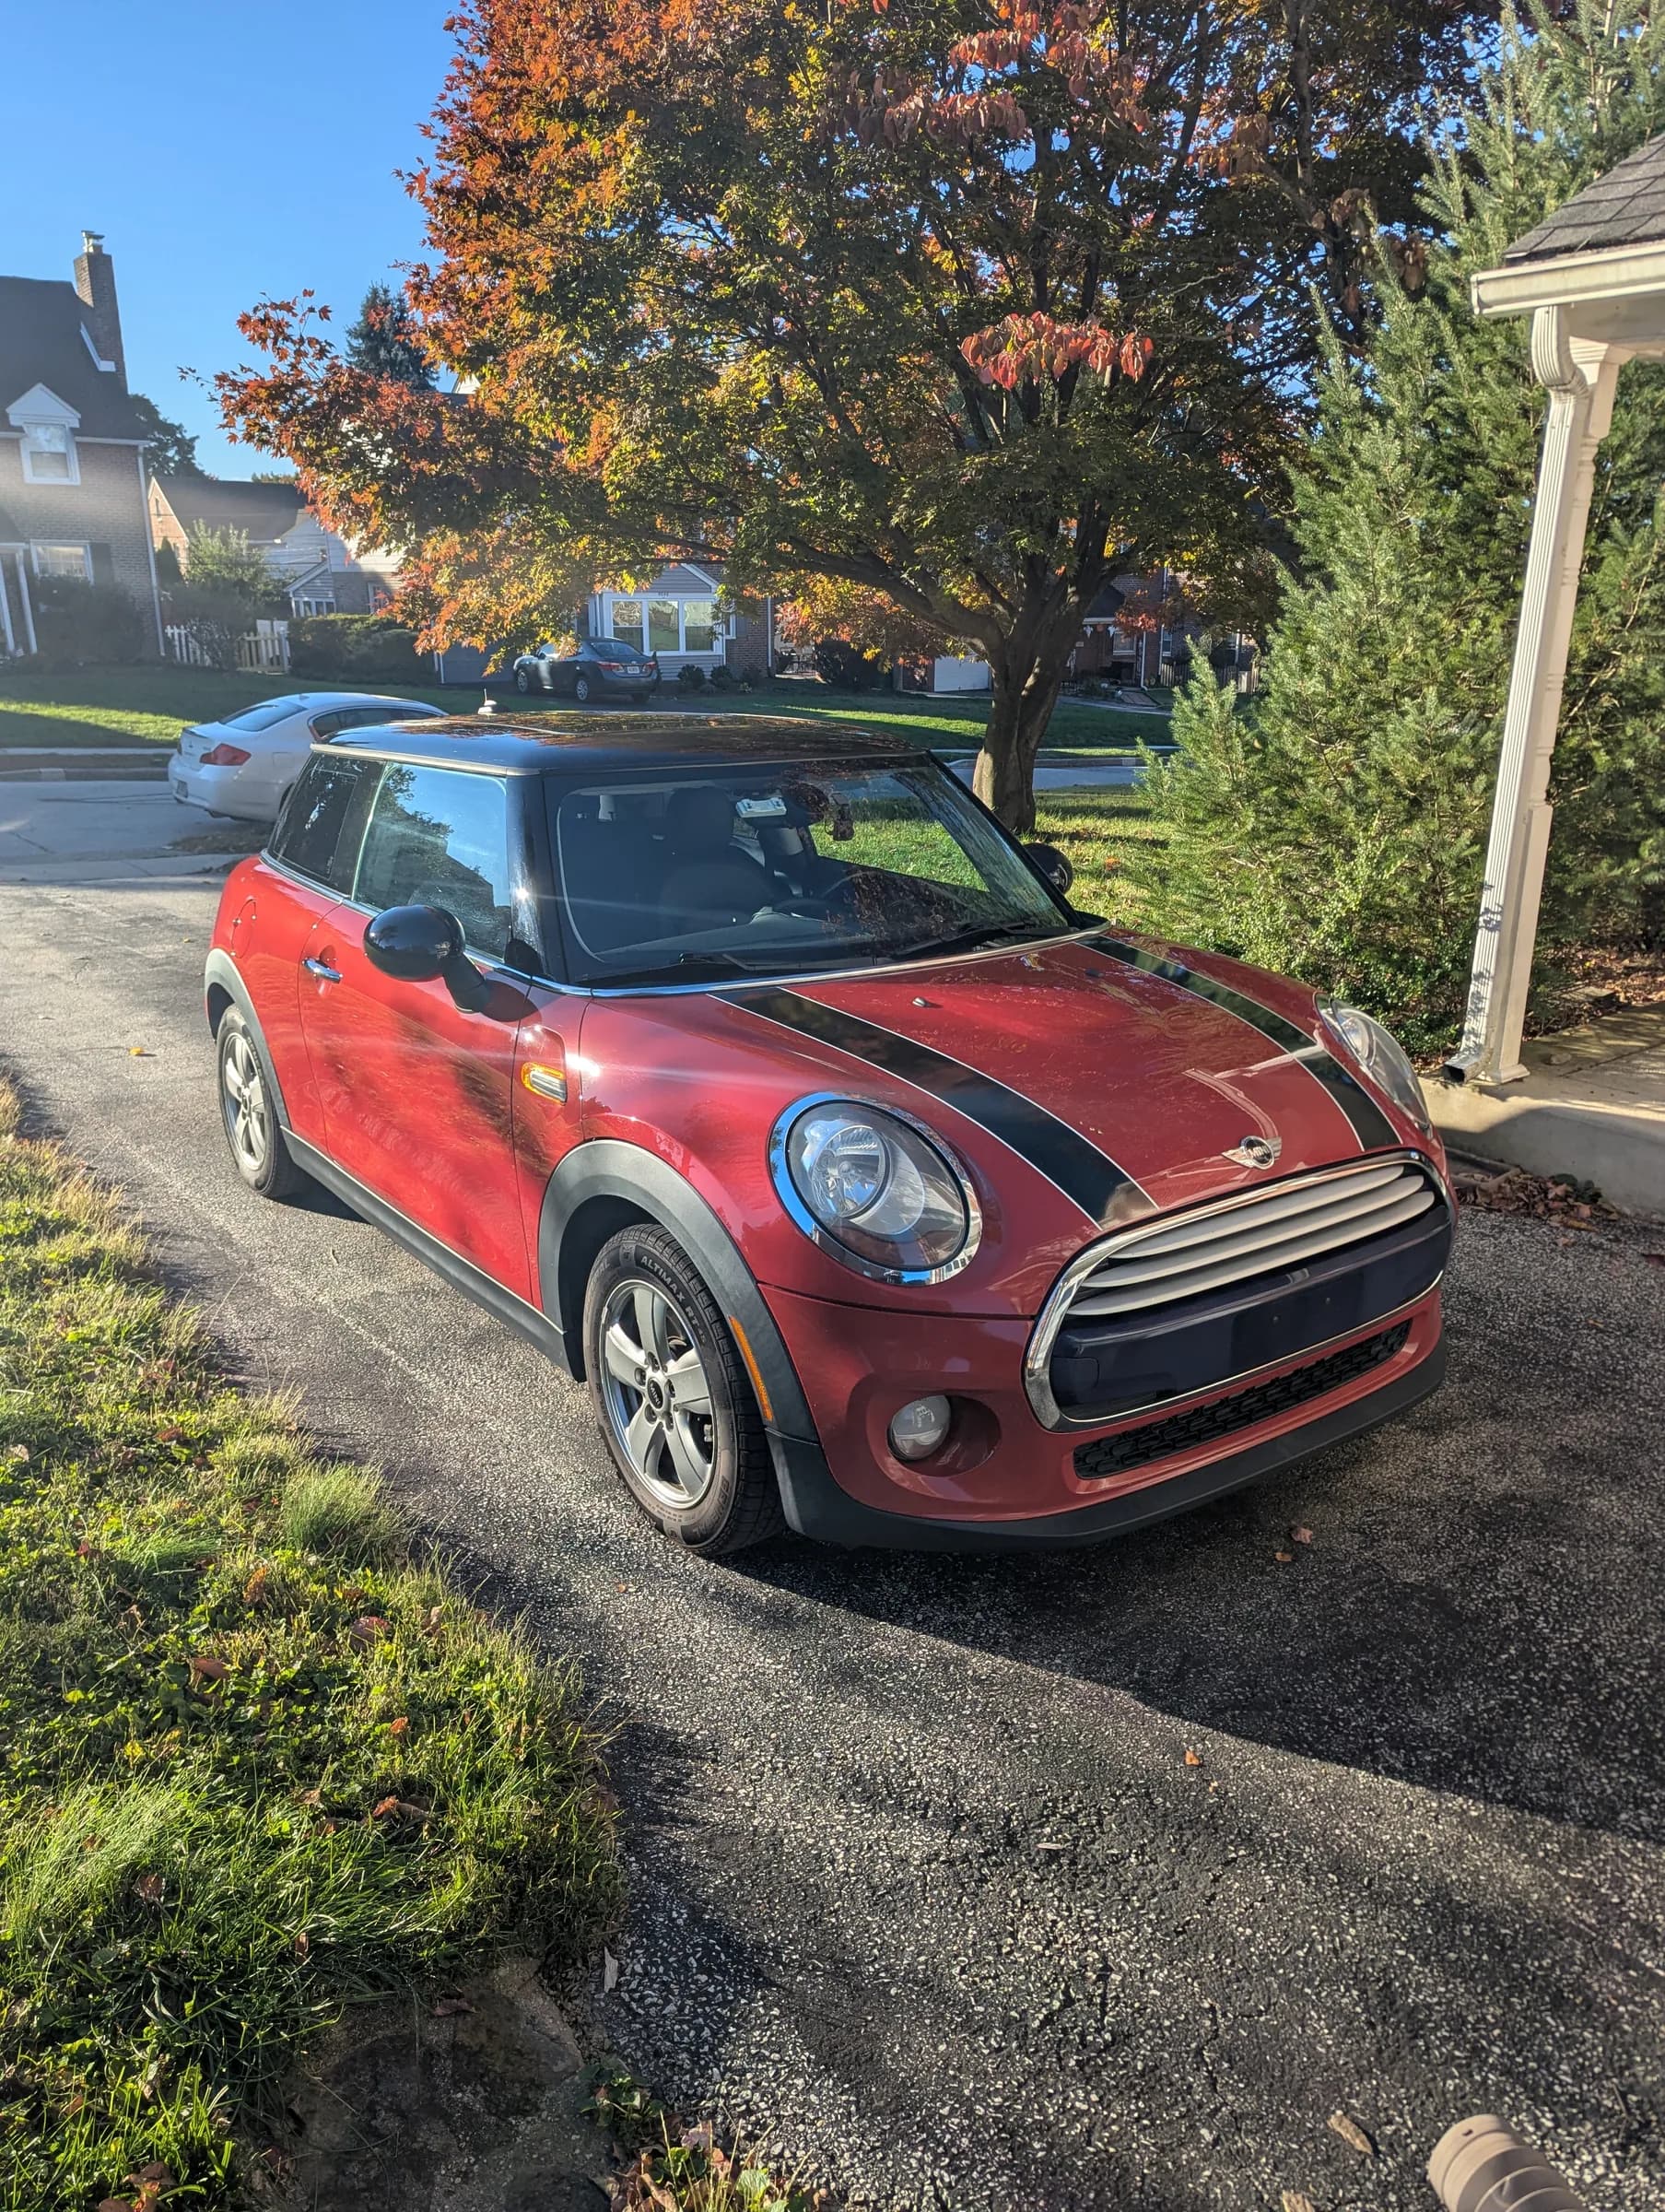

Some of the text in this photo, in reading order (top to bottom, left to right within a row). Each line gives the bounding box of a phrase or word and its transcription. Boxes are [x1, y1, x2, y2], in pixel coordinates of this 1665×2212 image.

[1249, 1146, 1271, 1159] MINI
[640, 1255, 686, 1302] ALTIMAX
[650, 1382, 662, 1406] MINI
